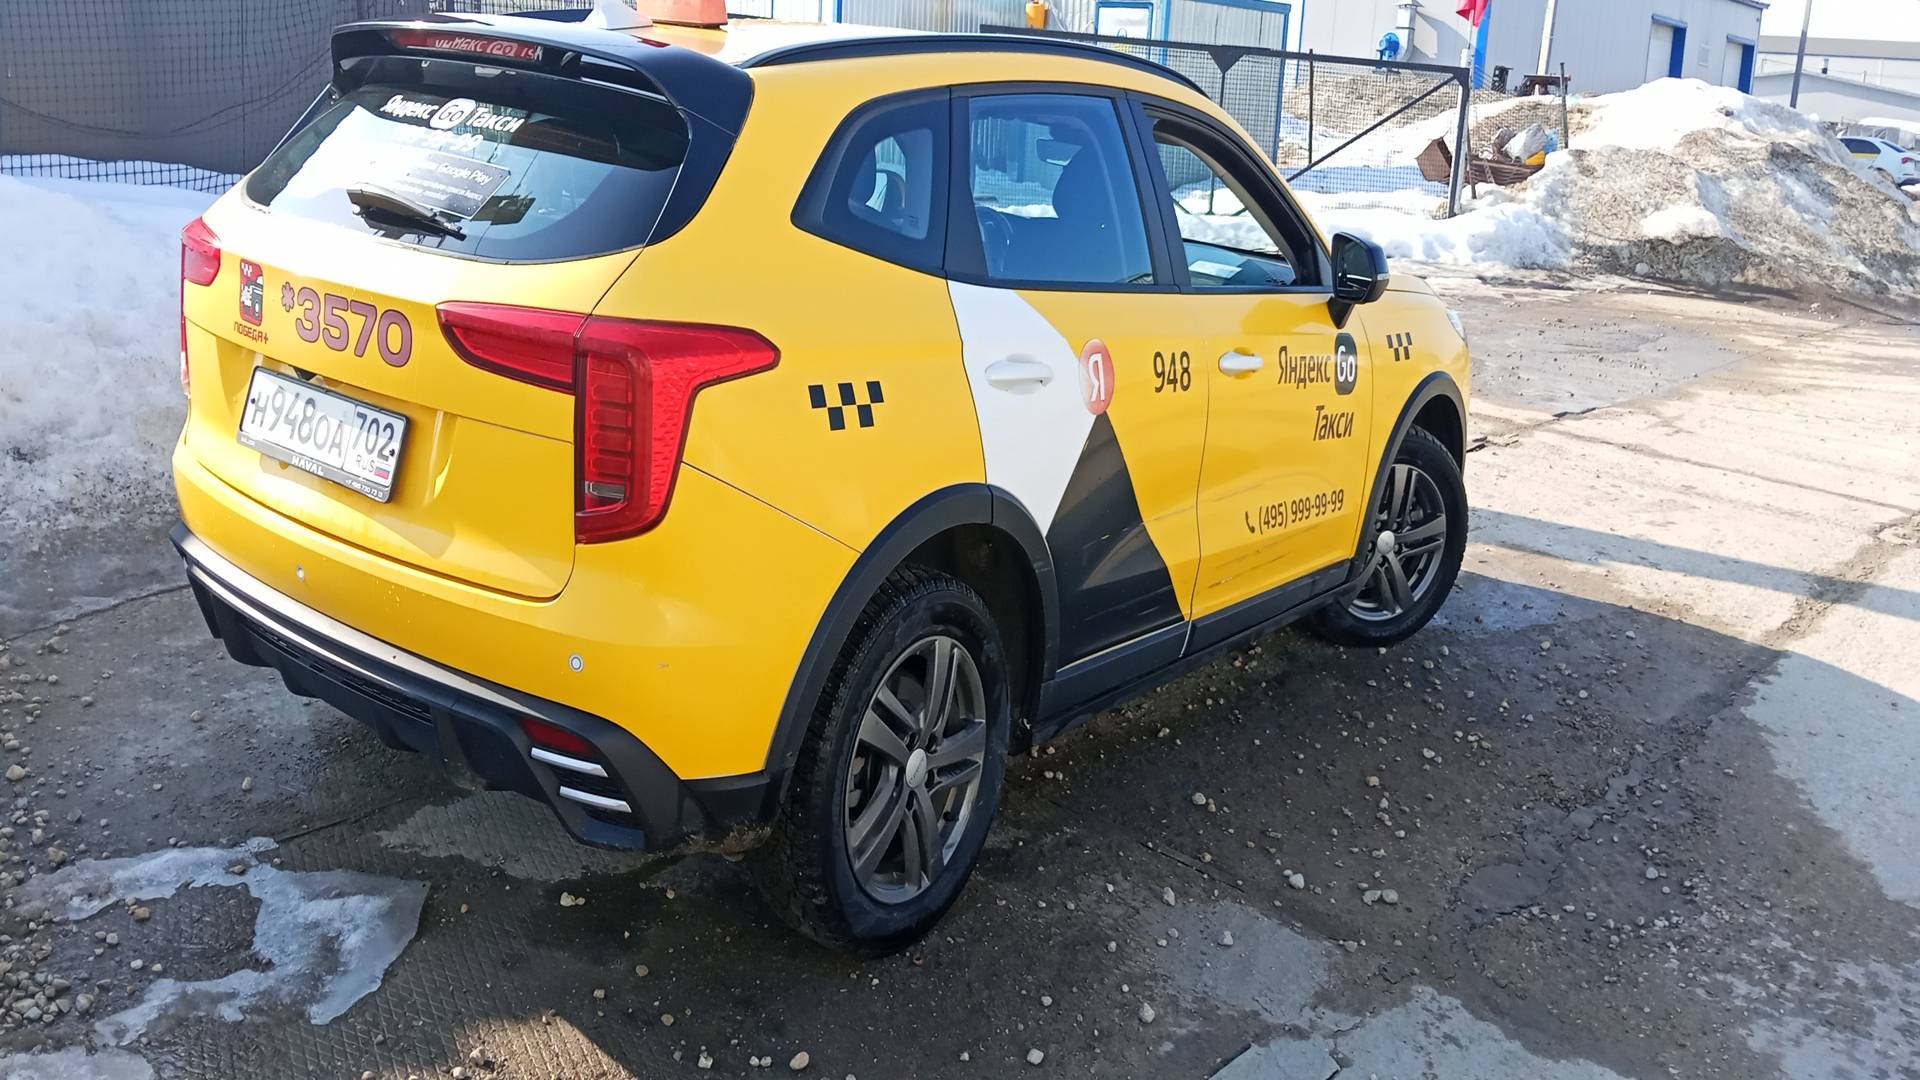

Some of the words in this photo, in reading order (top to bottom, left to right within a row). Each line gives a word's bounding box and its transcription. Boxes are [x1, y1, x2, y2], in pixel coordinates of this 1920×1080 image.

[380, 94, 439, 120] Яндекс
[466, 107, 525, 133] Такси
[1087, 353, 1106, 402] Я
[1152, 350, 1191, 393] 948
[1277, 345, 1331, 389] Яндекс
[1336, 345, 1356, 382] Go
[353, 411, 395, 462] 702
[1313, 404, 1354, 441] Такси
[1258, 503, 1288, 536] (495)
[1291, 489, 1344, 524] 999-99-99
